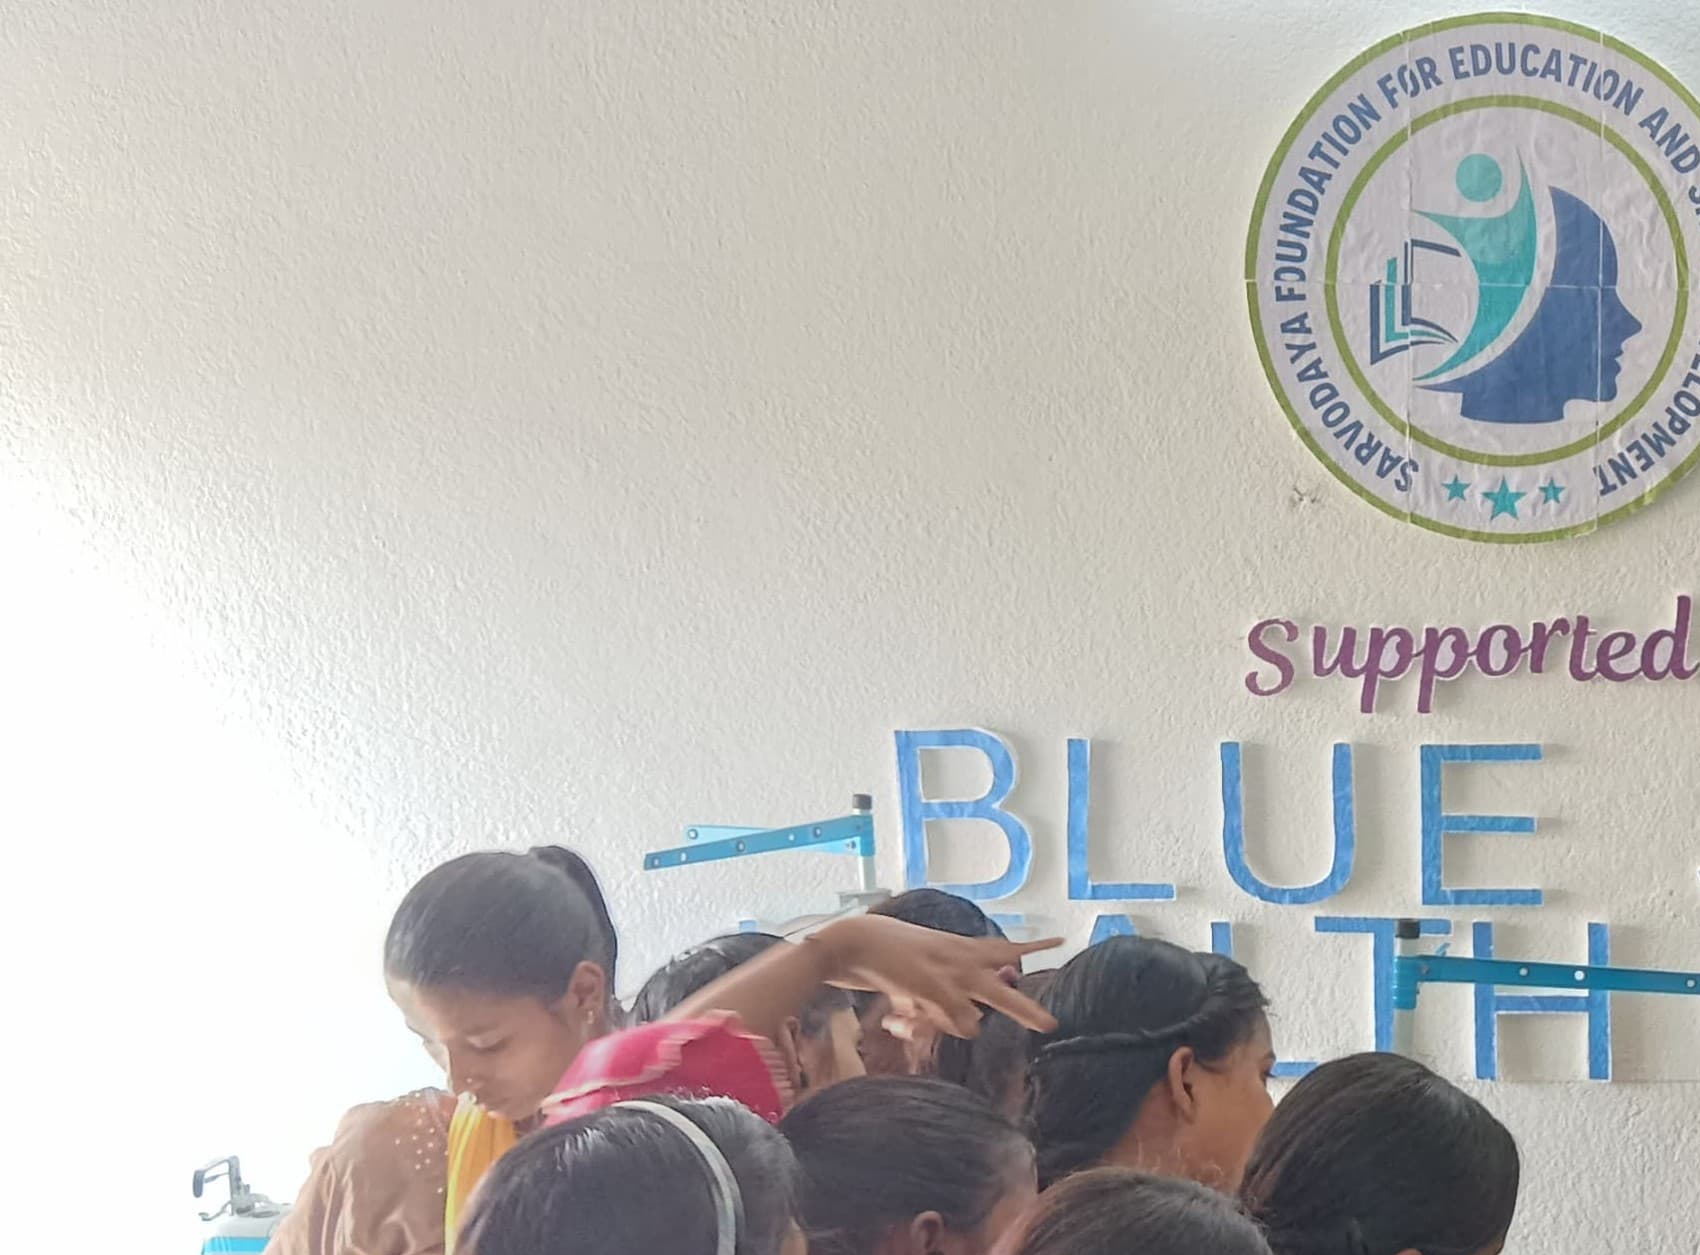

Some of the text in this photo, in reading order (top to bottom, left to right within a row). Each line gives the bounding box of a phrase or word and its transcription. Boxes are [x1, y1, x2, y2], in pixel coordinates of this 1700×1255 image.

[1376, 57, 1442, 109] FOR
[1449, 42, 1645, 115] EDUCATION
[1275, 93, 1382, 302] FOUNDATION
[1638, 107, 1700, 175] AND
[1280, 311, 1419, 493] SARVODAYA
[1245, 595, 1699, 713] Supported
[894, 729, 1543, 905] BLUE
